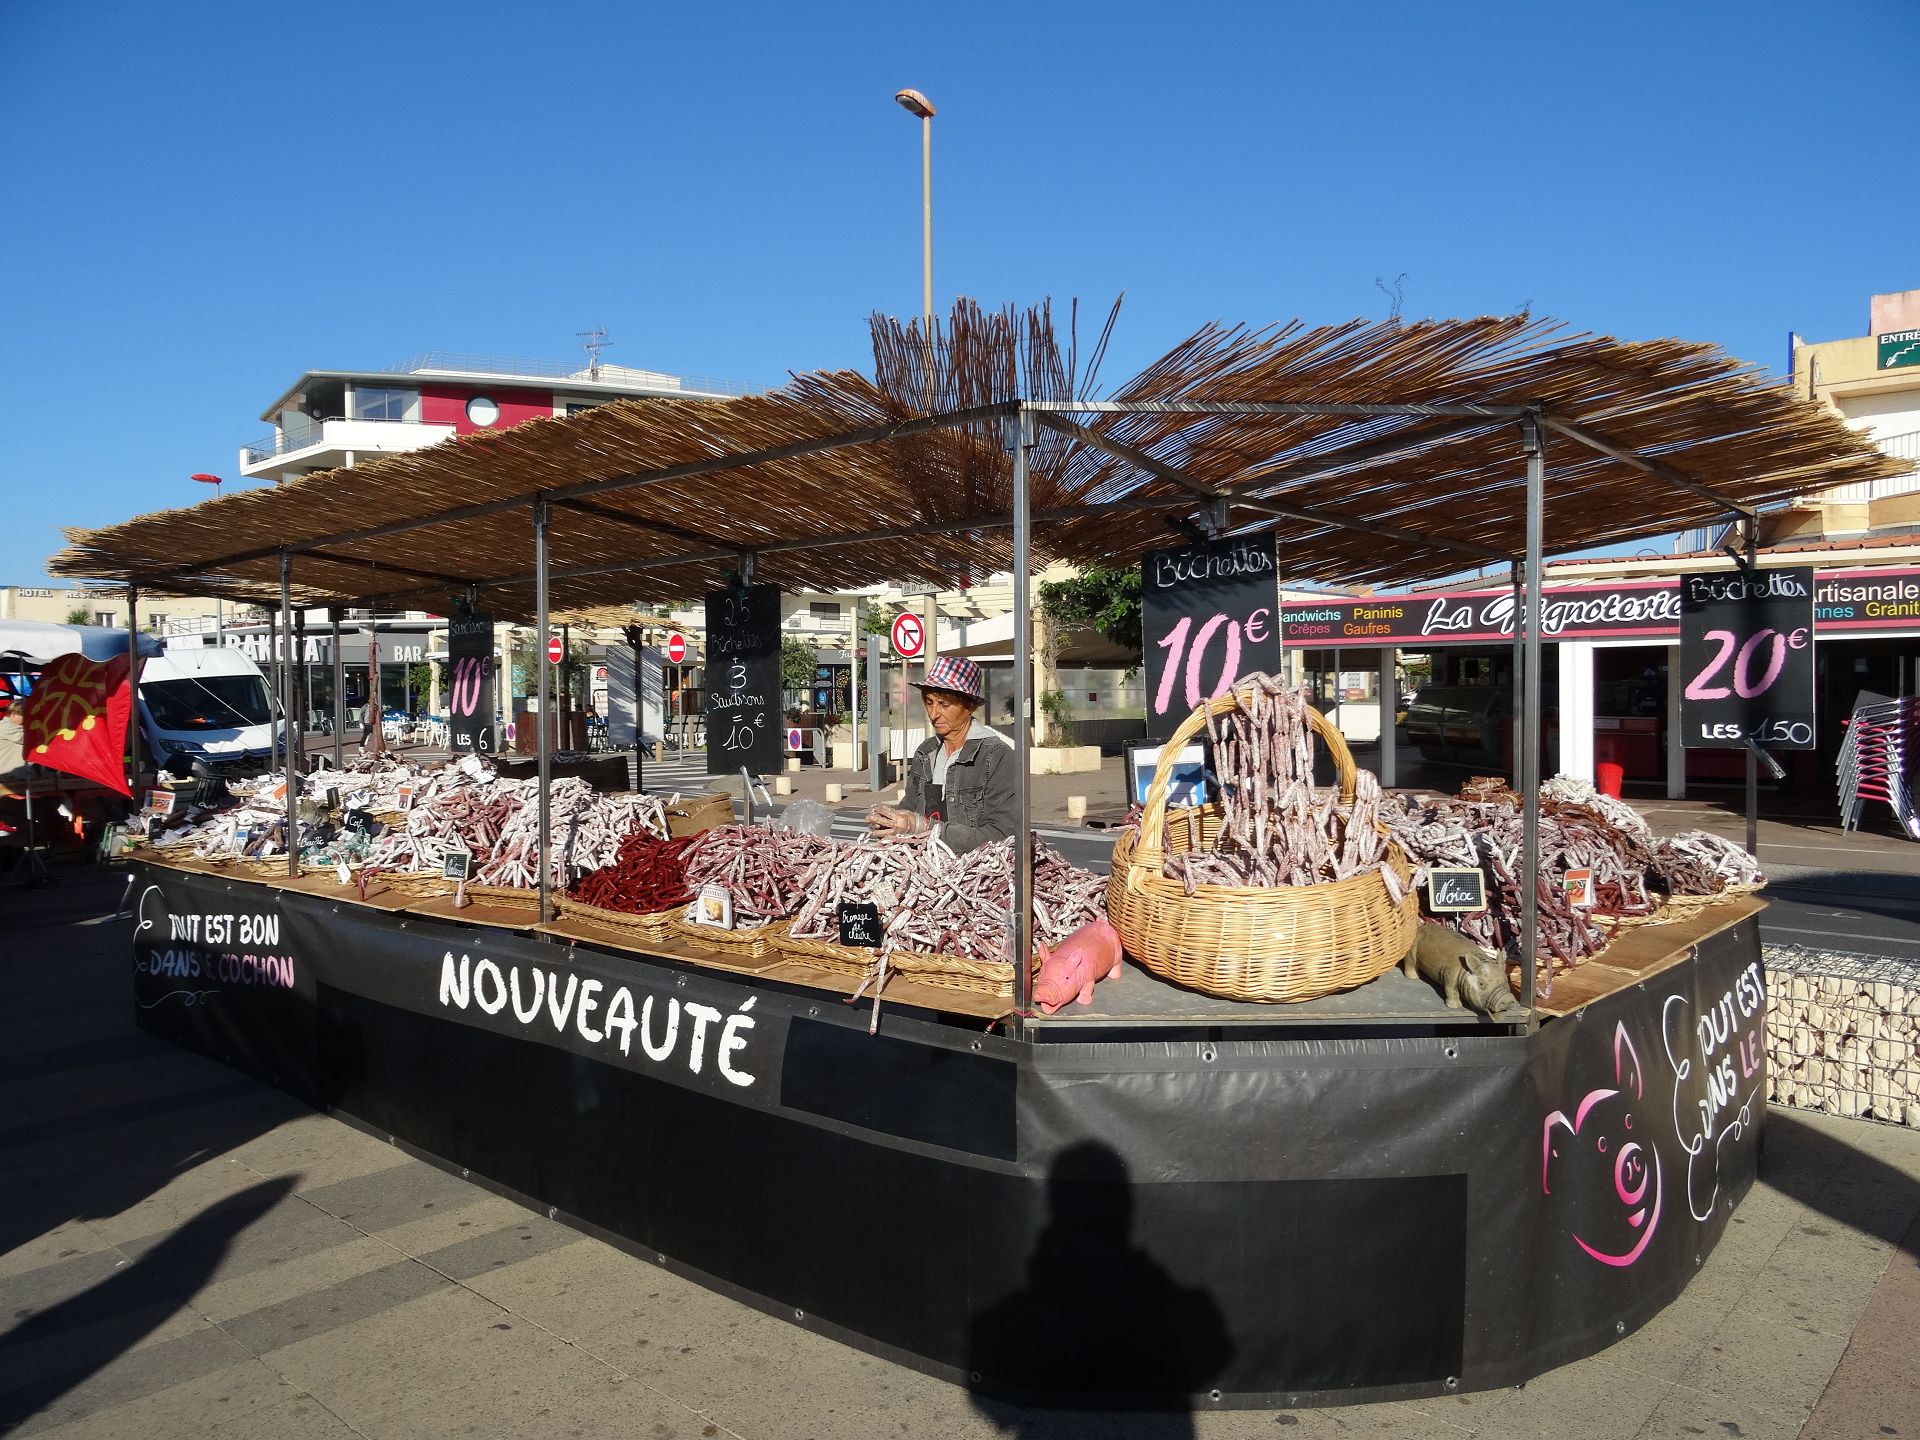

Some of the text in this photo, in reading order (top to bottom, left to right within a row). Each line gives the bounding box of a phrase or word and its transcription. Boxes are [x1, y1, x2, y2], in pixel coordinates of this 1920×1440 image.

[17, 588, 53, 598] HOTEL
[1814, 580, 1919, 603] rtisanale
[1280, 606, 1404, 623] andwichs Paninis
[1421, 590, 1680, 636] La Ggnoterie
[1865, 601, 1920, 617] Granit
[1289, 622, 1391, 636] Crêpes Gaufres
[394, 645, 422, 662] BAR
[730, 665, 747, 689] 3
[456, 727, 487, 750] LES 6
[1701, 717, 1812, 744] LES 150
[205, 914, 235, 944] EST
[239, 914, 279, 946] BON
[150, 950, 200, 978] DANS
[218, 953, 295, 989] COCHON
[1736, 962, 1765, 1018] EST
[439, 951, 757, 1087] NOUVEAUTÉ
[1739, 1030, 1760, 1079] LE
